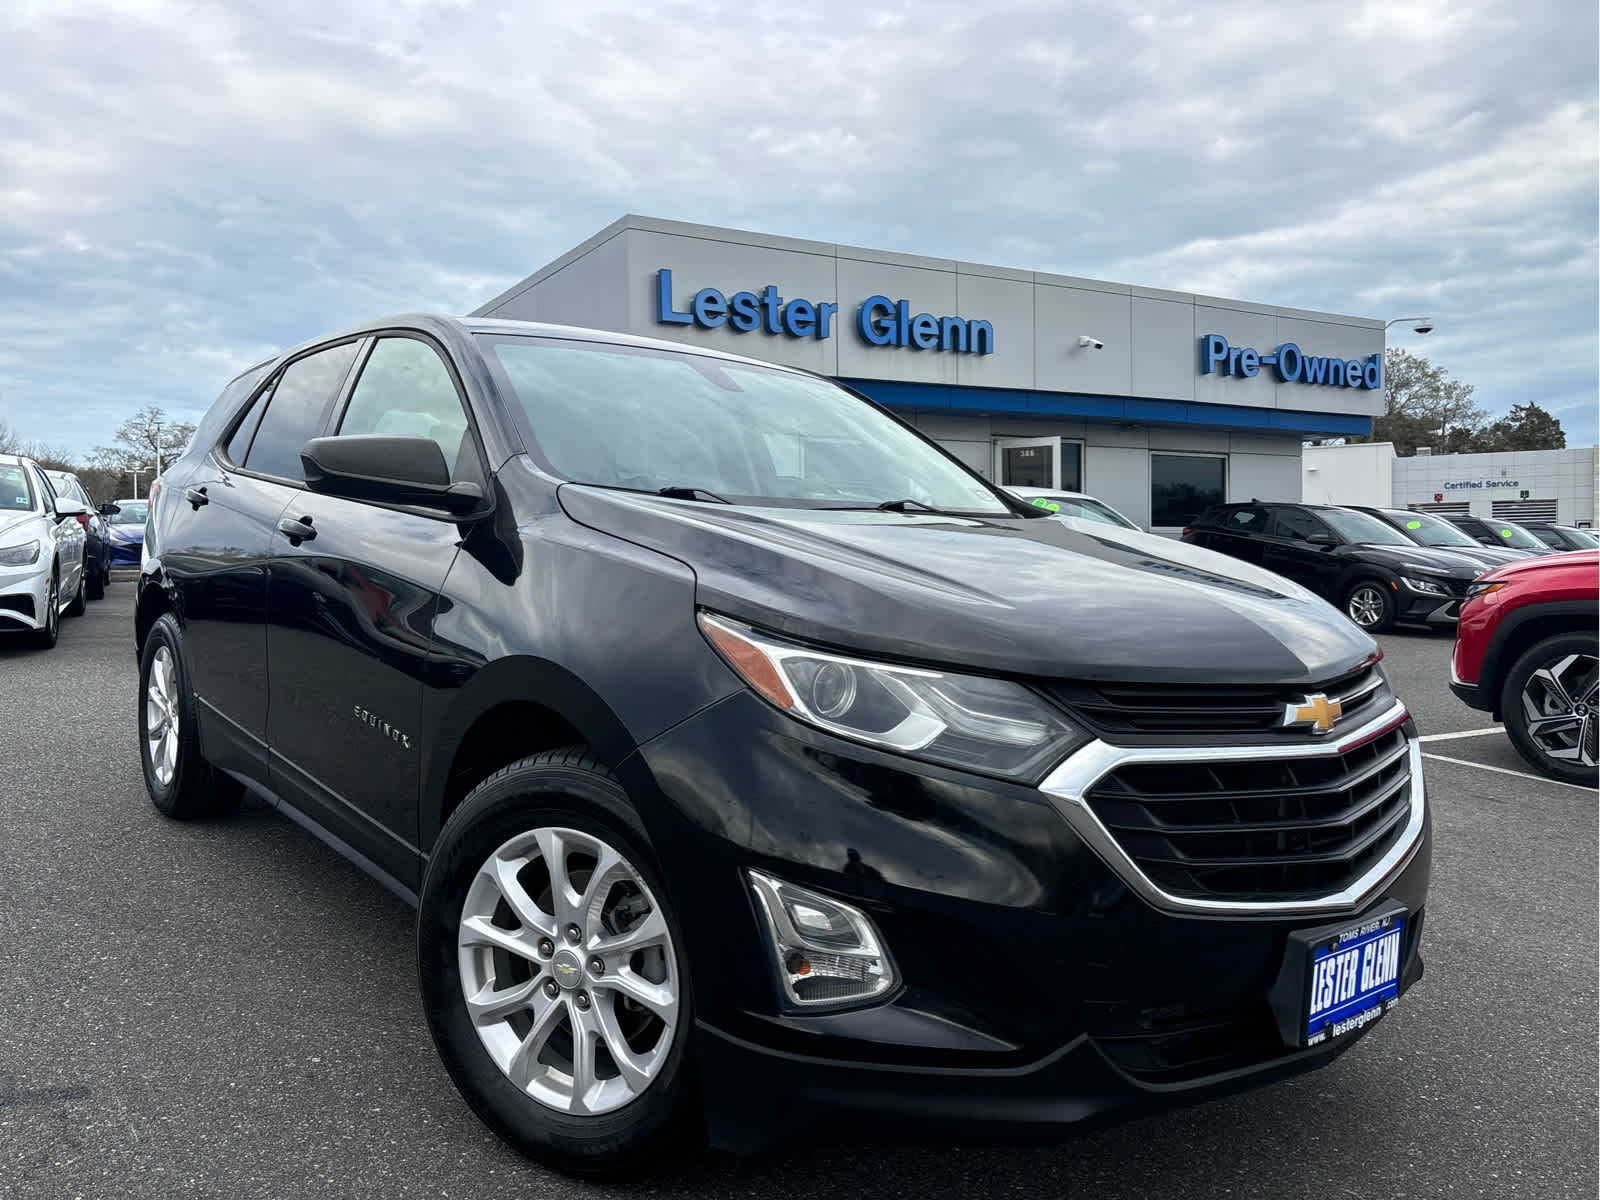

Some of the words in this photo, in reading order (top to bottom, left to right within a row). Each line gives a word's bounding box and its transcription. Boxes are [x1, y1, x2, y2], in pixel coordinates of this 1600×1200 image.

[656, 269, 838, 339] Lester
[856, 295, 994, 355] Glenn
[1201, 334, 1382, 389] Pre-Owned
[1444, 480, 1482, 490] Certified
[1486, 480, 1519, 488] Service
[354, 705, 409, 749] EQUINOX
[1339, 929, 1359, 943] TOMS
[1310, 949, 1359, 1015] LESTER
[1361, 932, 1400, 993] GLENN
[1332, 1006, 1382, 1037] lesterglenn
